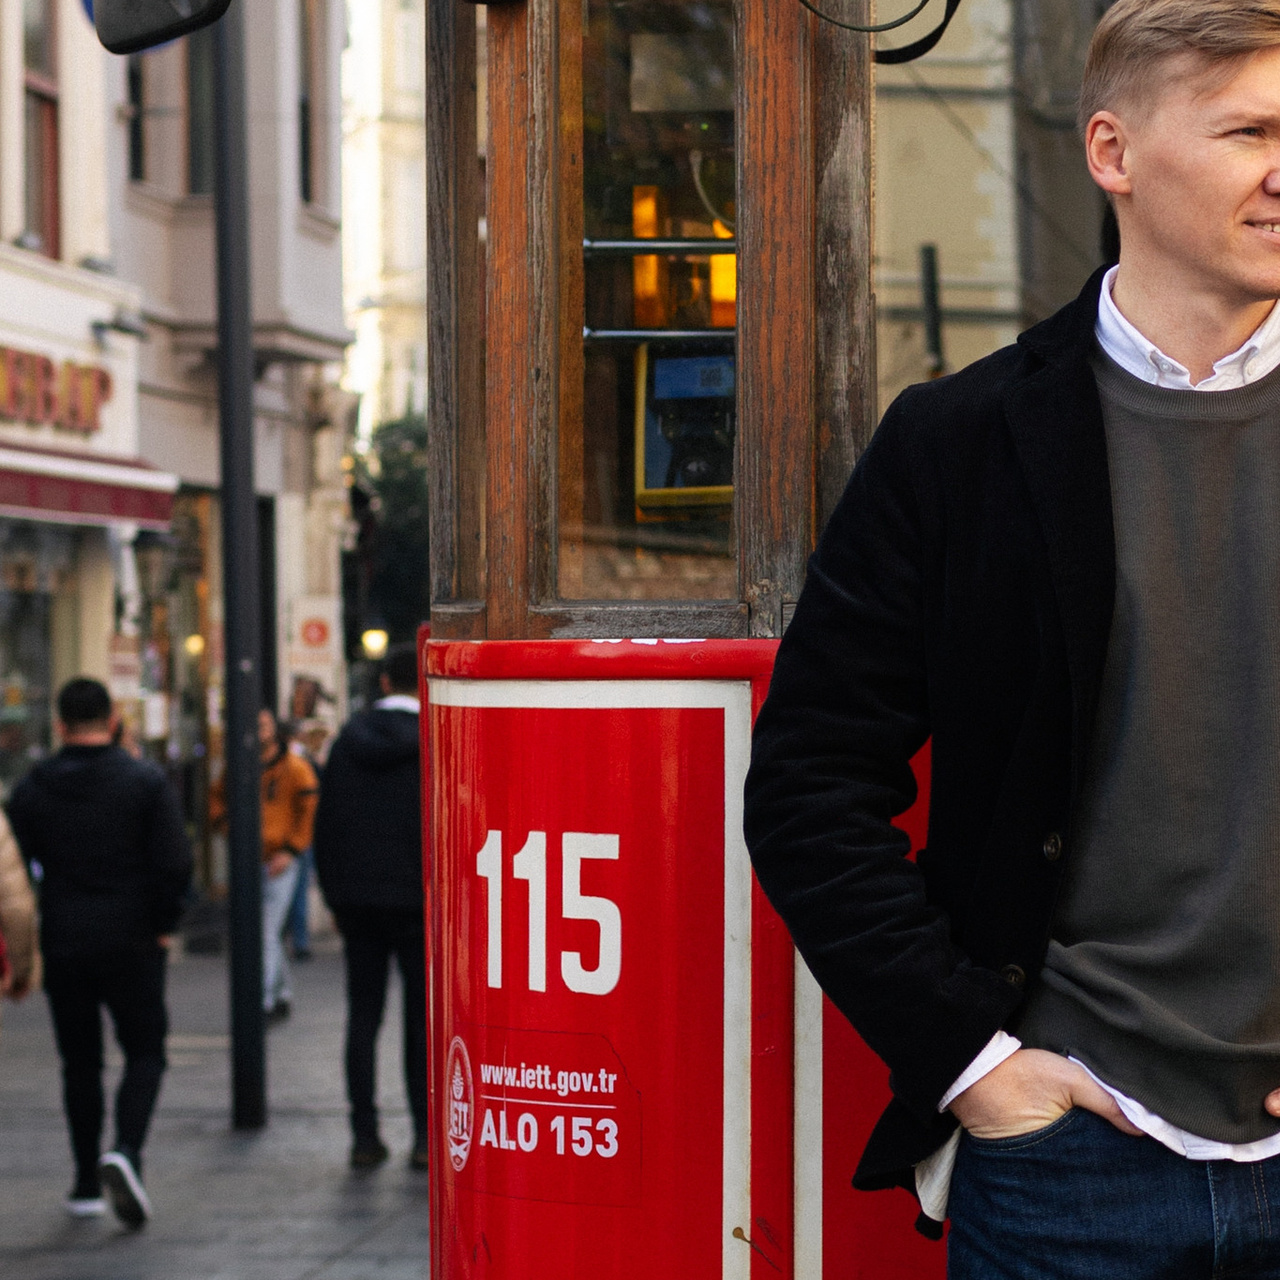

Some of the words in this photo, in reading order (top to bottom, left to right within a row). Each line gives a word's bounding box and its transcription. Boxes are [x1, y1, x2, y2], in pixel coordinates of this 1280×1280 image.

[476, 829, 622, 995] 115
[480, 1061, 617, 1097] www.iett.gov.tr
[480, 1108, 539, 1153] ALO
[550, 1115, 619, 1158] 153
